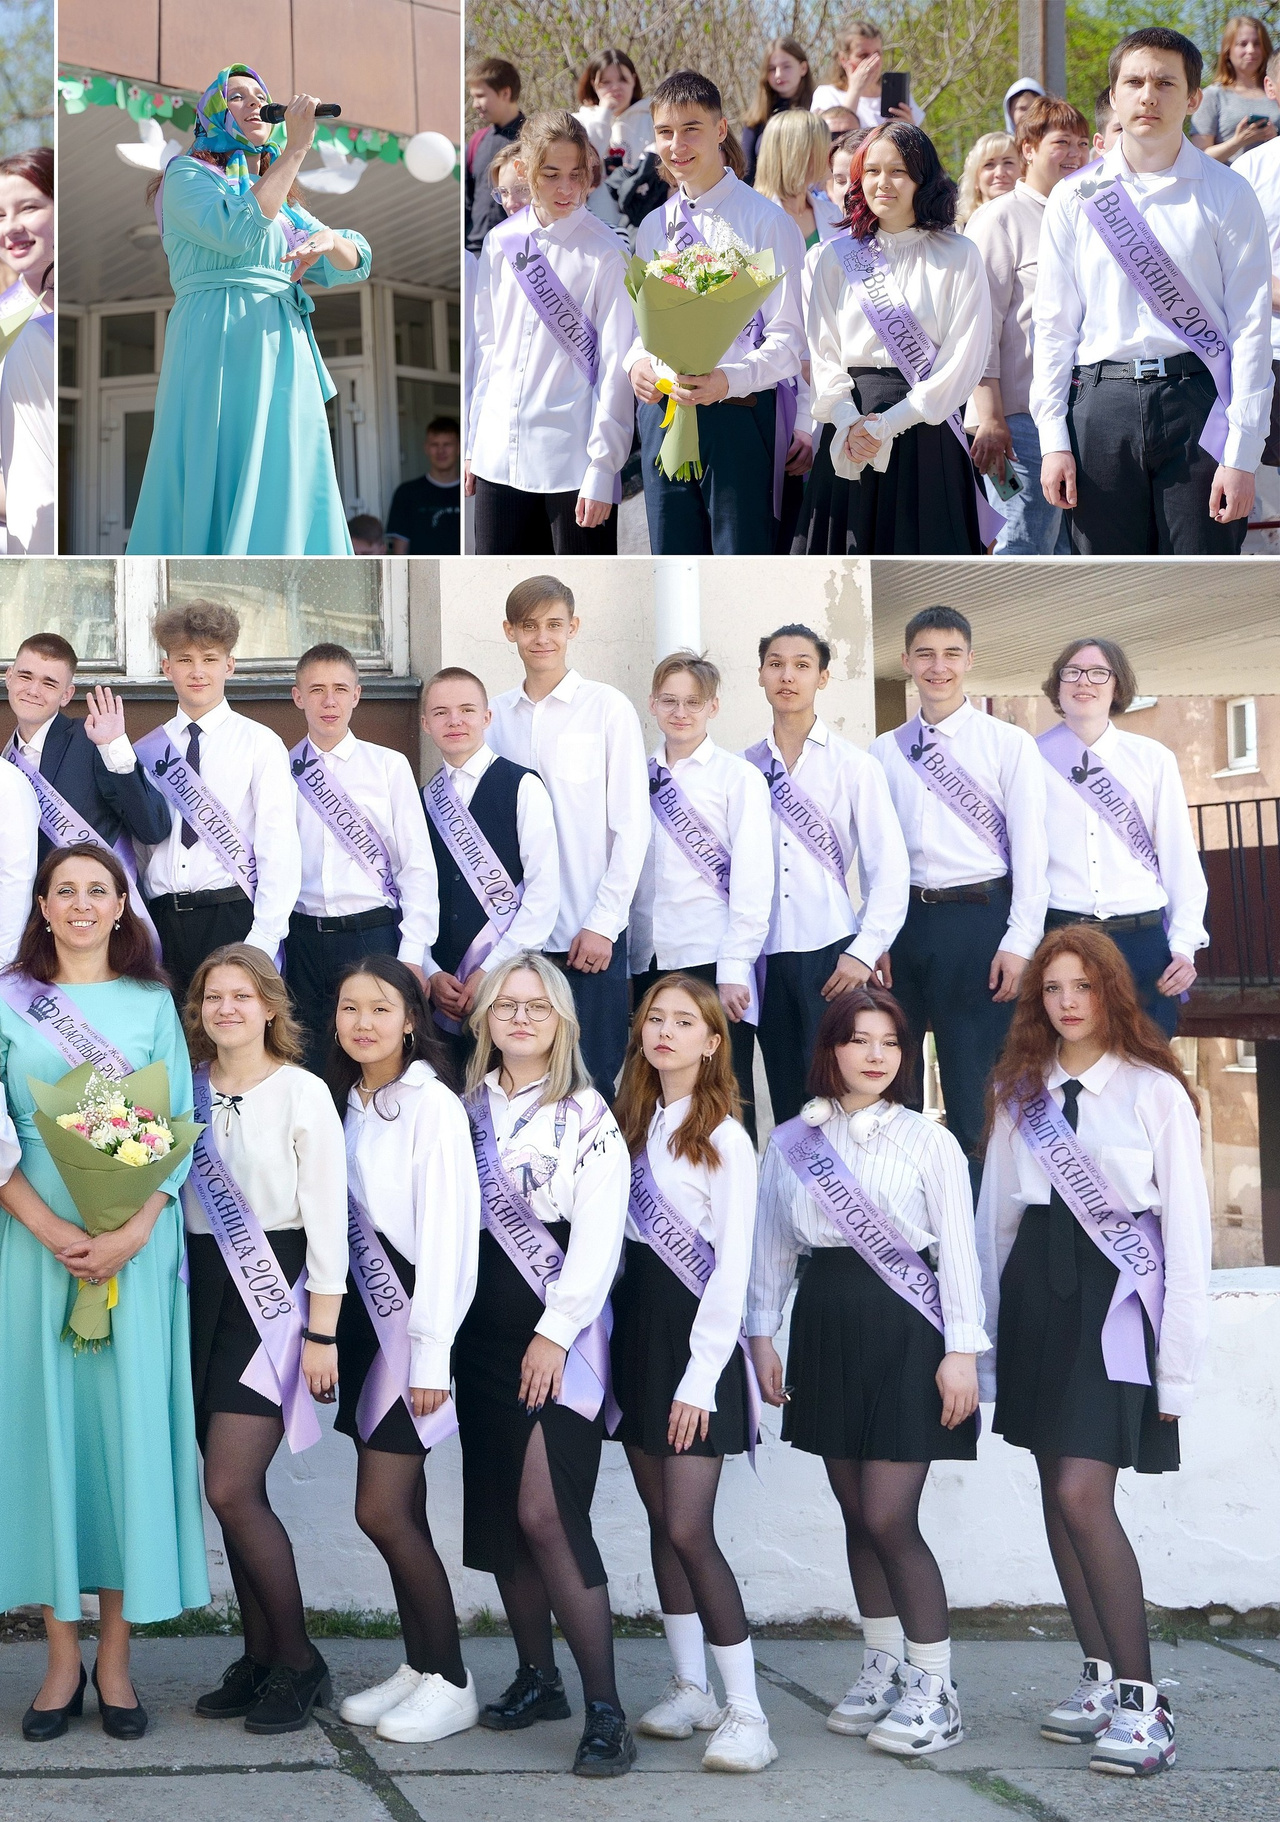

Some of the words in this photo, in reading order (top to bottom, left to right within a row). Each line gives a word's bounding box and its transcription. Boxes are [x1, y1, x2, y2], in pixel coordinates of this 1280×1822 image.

[1094, 190, 1185, 311] ВЫПУСКНИК
[1172, 307, 1225, 358] 2023
[1137, 222, 1163, 257] СМЕКАЛОВ
[1162, 257, 1178, 278] ИВАН
[917, 331, 930, 351] КИРА
[167, 766, 246, 860] ВЫПУСКНИК
[304, 768, 383, 865] ВЫПУСКНИК
[923, 752, 1009, 843] ВЫПУСКНИК
[429, 776, 488, 871] ВЫПУСКНИК
[477, 869, 519, 916] 2023
[658, 787, 730, 882] ВЫПУСКНИК
[52, 1015, 106, 1068] КЛАССНЫЙ
[107, 1045, 129, 1071] ЖАННА
[232, 1188, 251, 1214] ДАРЬЯ
[1022, 1098, 1114, 1226] ВЫПУСКНИЦА
[1100, 1220, 1157, 1276] 2023
[1080, 1155, 1109, 1191] НАДЕЖДА
[191, 1124, 256, 1261] ЫПУСКНИЦА
[240, 1258, 292, 1321] 2023
[510, 1193, 531, 1220] КСЕНИЯ
[656, 1194, 684, 1227] ЯКИМОВА
[682, 1225, 704, 1248] ДАРЬЯ
[807, 1156, 911, 1281] ВЫПУСКНИЦА
[853, 1187, 879, 1219] ОРЕХОВА
[877, 1217, 899, 1241] ДАРЬЯ
[359, 1257, 404, 1318] 2023
